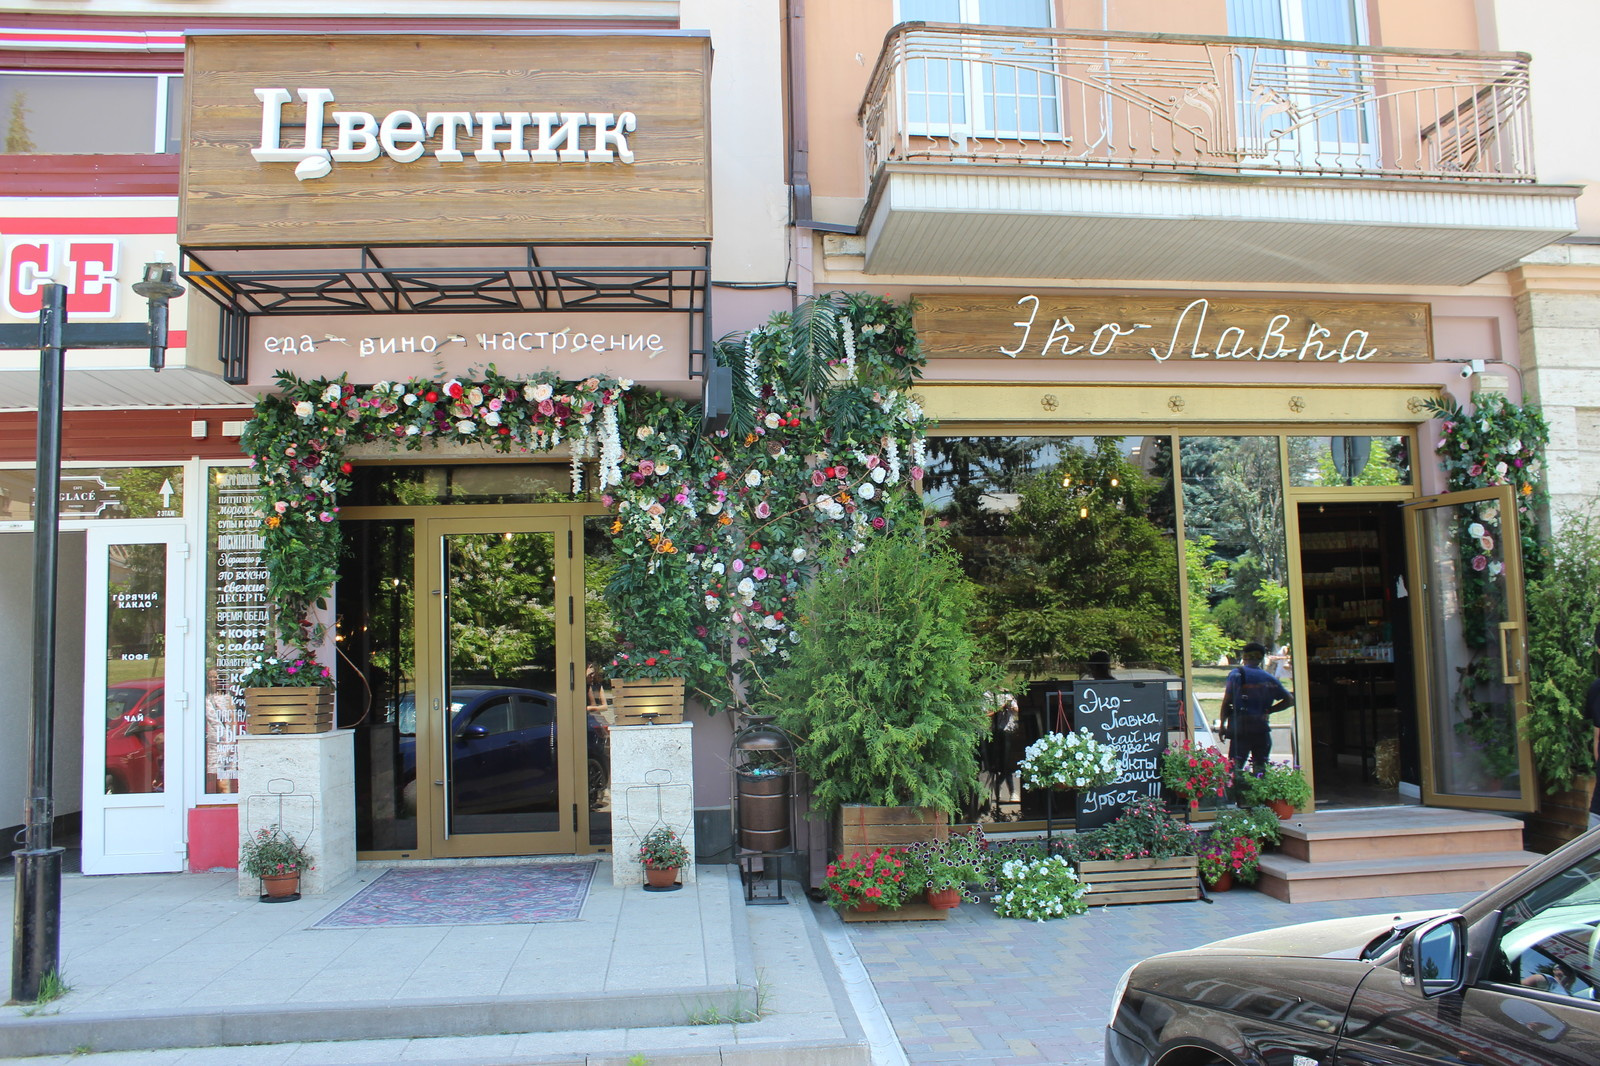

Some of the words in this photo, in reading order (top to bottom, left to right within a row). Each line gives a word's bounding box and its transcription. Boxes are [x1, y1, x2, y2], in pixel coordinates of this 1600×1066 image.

[251, 88, 637, 181] Цветник
[264, 334, 315, 355] еда
[360, 335, 437, 356] вино
[482, 332, 664, 355] настроение
[58, 490, 96, 501] GLACÉ
[218, 520, 237, 528] СУПЫ
[244, 520, 262, 528] САЛА
[218, 534, 267, 550] ВОСХИТИТЕЛЬН
[223, 582, 266, 593] свежие
[113, 592, 158, 601] ГОРЯЧИЙ
[217, 611, 242, 621] ВРЕМЯ
[244, 611, 270, 621] ОБЕДА
[228, 629, 258, 638] КОФЕ
[124, 714, 144, 722] ЧАЙ
[216, 725, 246, 743] РЫБ
